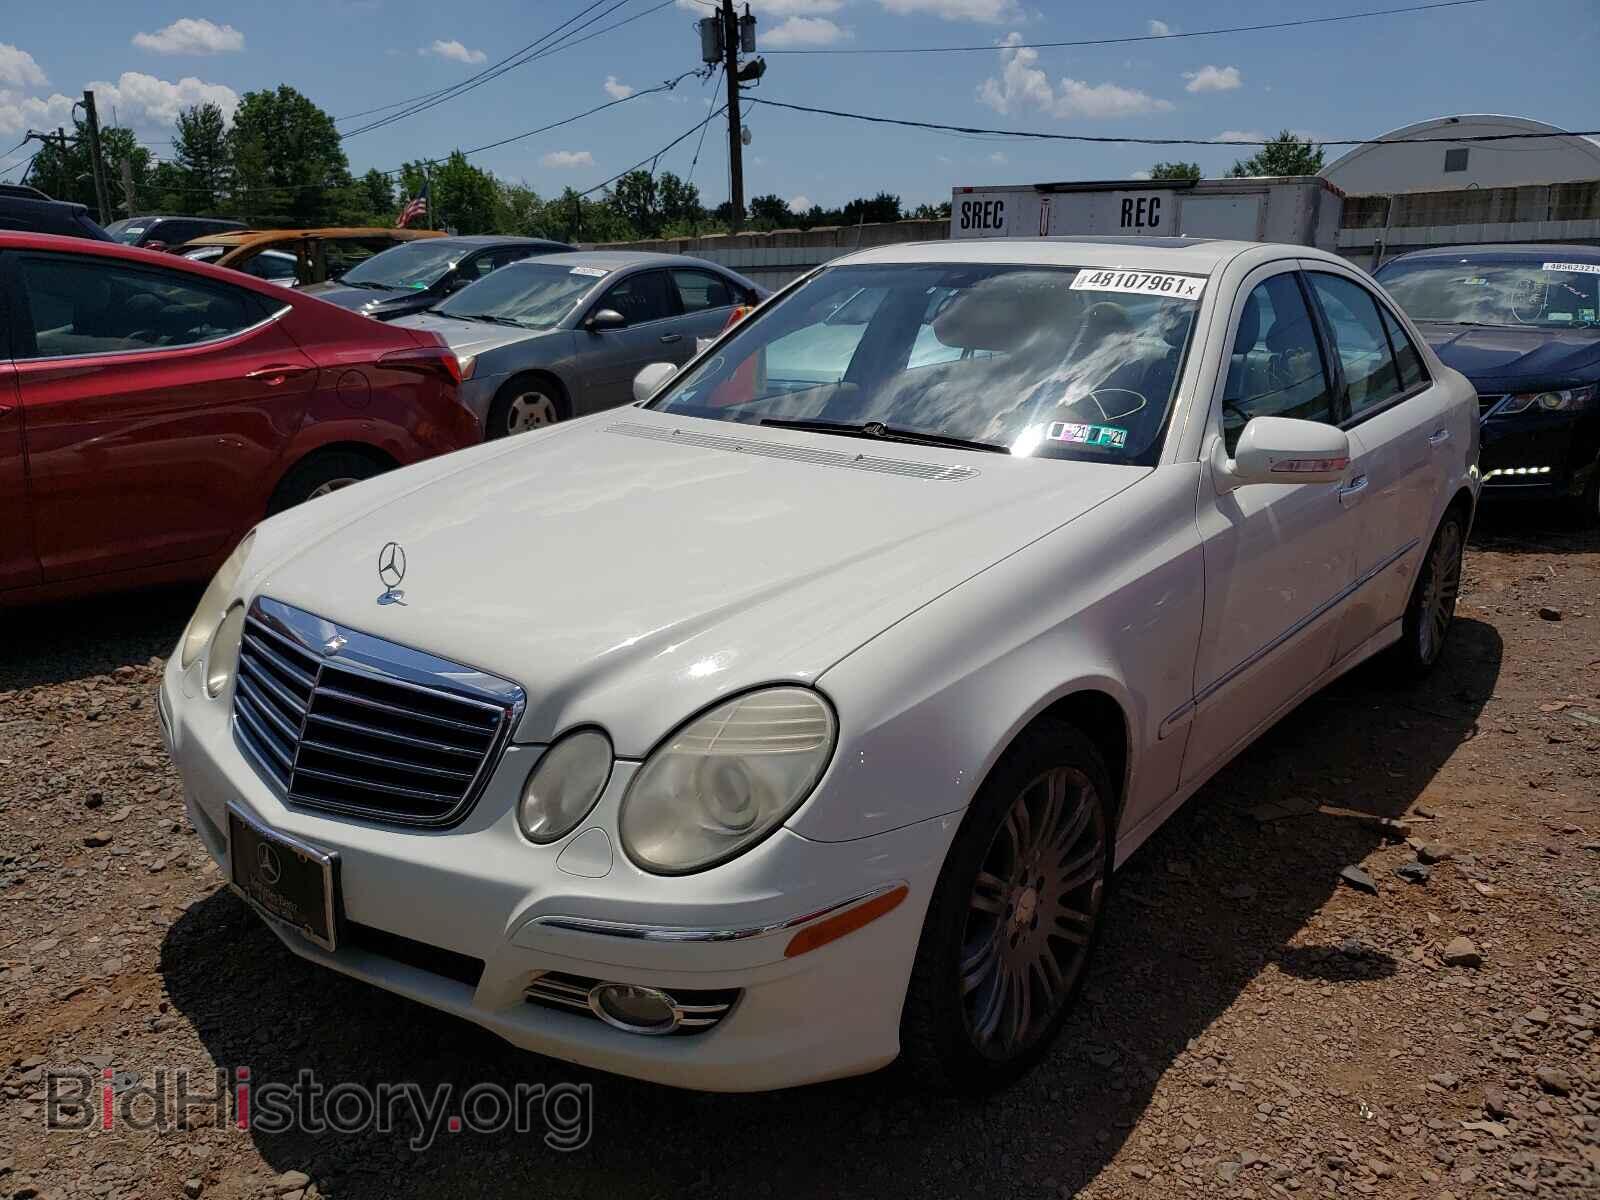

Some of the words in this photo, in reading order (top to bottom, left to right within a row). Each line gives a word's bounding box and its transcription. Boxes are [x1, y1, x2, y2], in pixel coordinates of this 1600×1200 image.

[960, 200, 1004, 229] SREC
[1120, 197, 1161, 228] REC
[1088, 271, 1186, 293] 48107961
